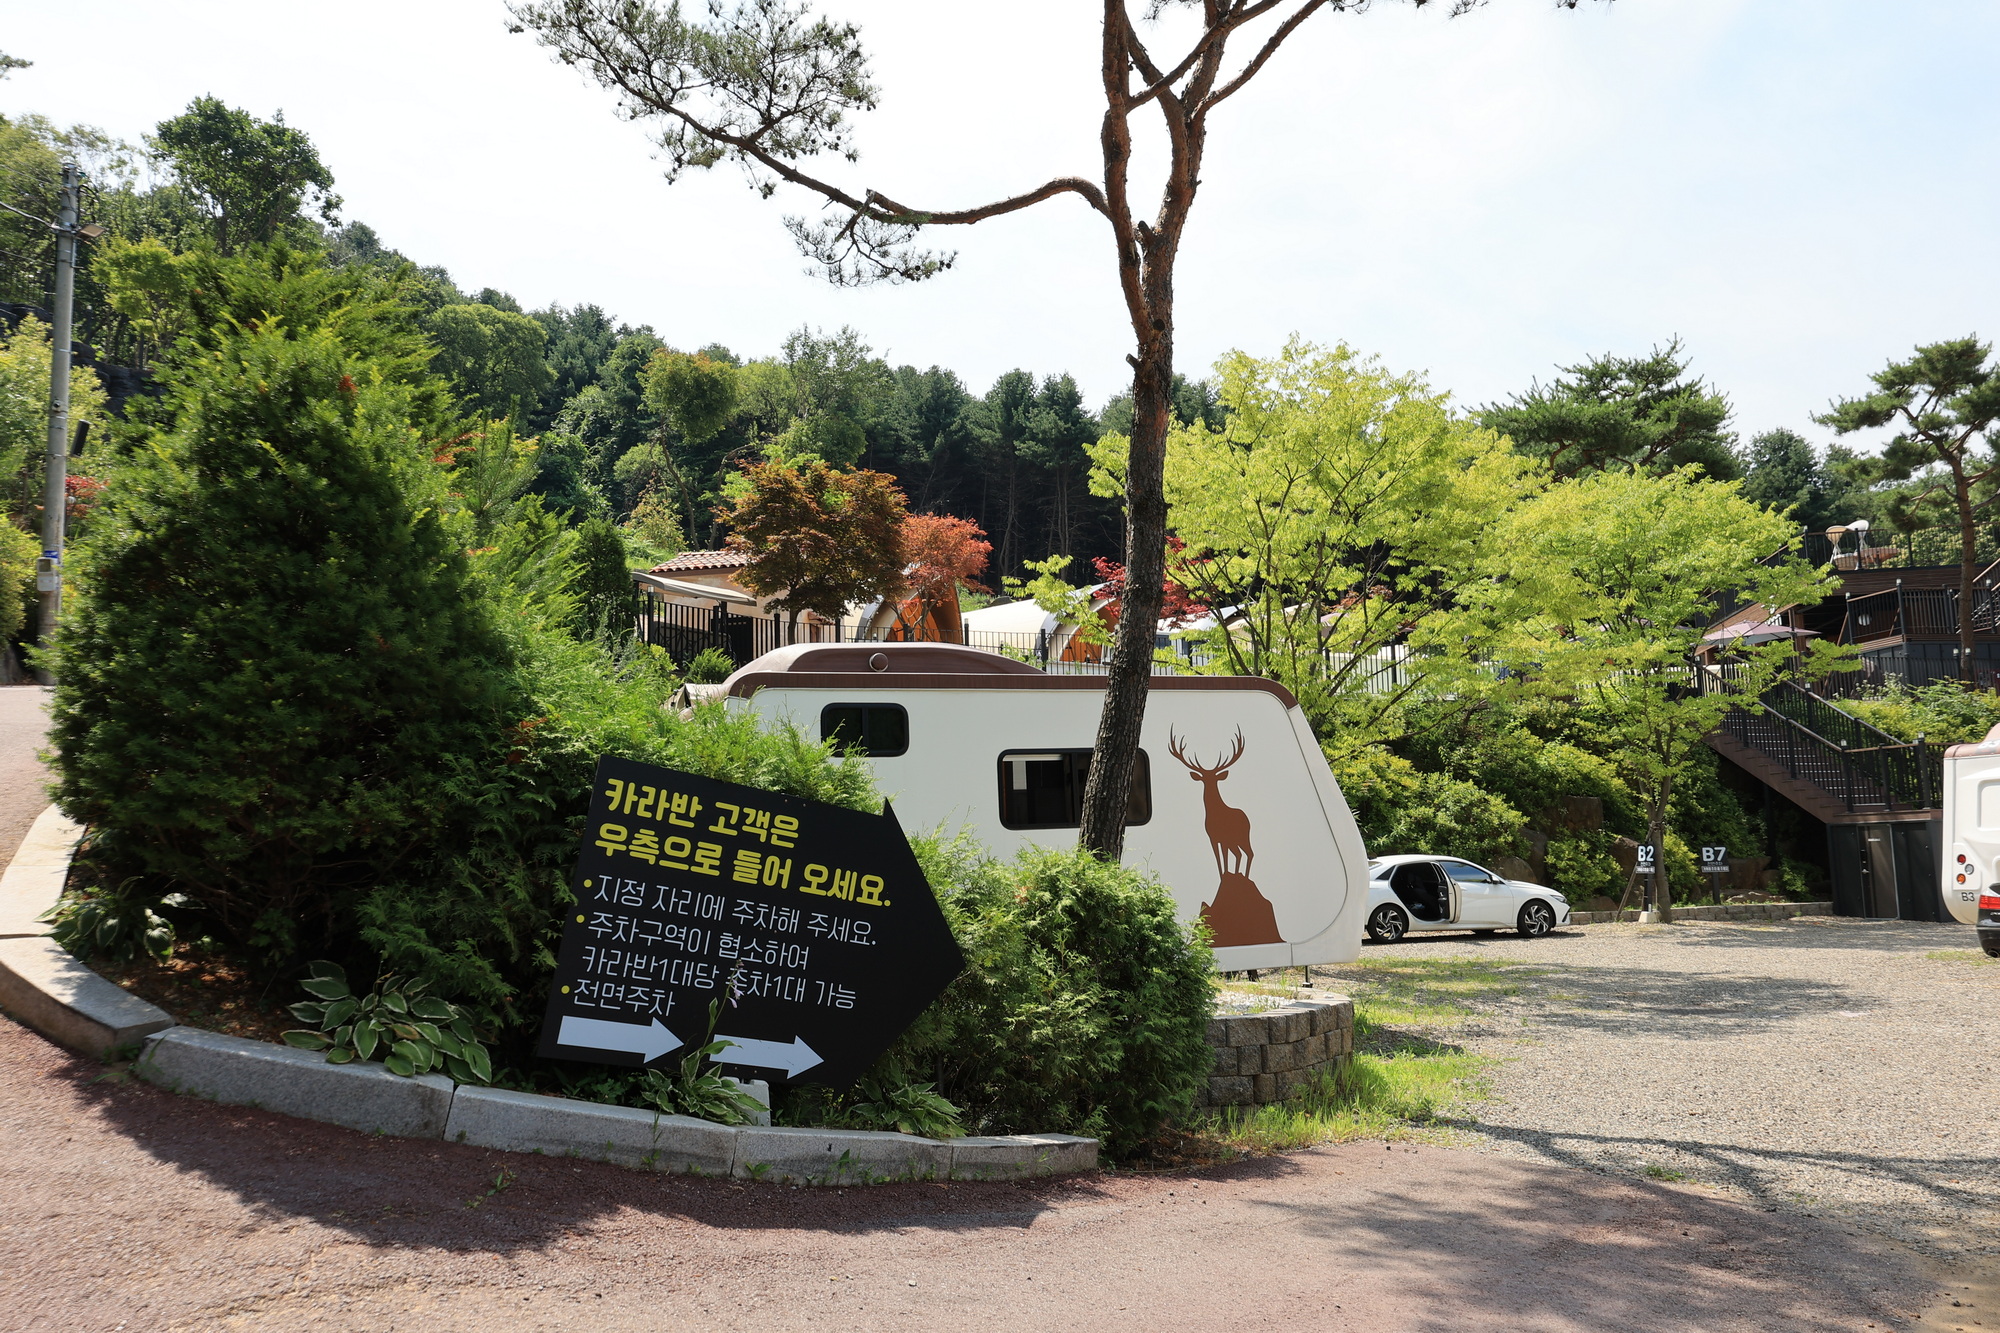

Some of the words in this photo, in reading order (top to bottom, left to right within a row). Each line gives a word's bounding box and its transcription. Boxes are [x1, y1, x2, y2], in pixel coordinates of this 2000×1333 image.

[605, 778, 702, 828] 카라반
[708, 802, 800, 848] 고객은
[595, 823, 723, 877] 우측으로
[732, 849, 793, 889] 들어
[799, 864, 891, 907] 오세요.
[1638, 845, 1654, 862] B2
[1702, 847, 1726, 862] B7
[594, 875, 646, 907] 지정
[652, 886, 725, 922] 자리에
[731, 900, 801, 934] 주차해
[807, 912, 877, 946] 주세요.
[1961, 892, 1975, 902] B3
[588, 911, 712, 955] 주차구역이
[718, 932, 810, 971] 협소하여
[573, 979, 676, 1017] 전면주차
[582, 946, 719, 989] 카라반1대당
[725, 968, 806, 1003] 주차1대
[815, 981, 857, 1010] 가능
